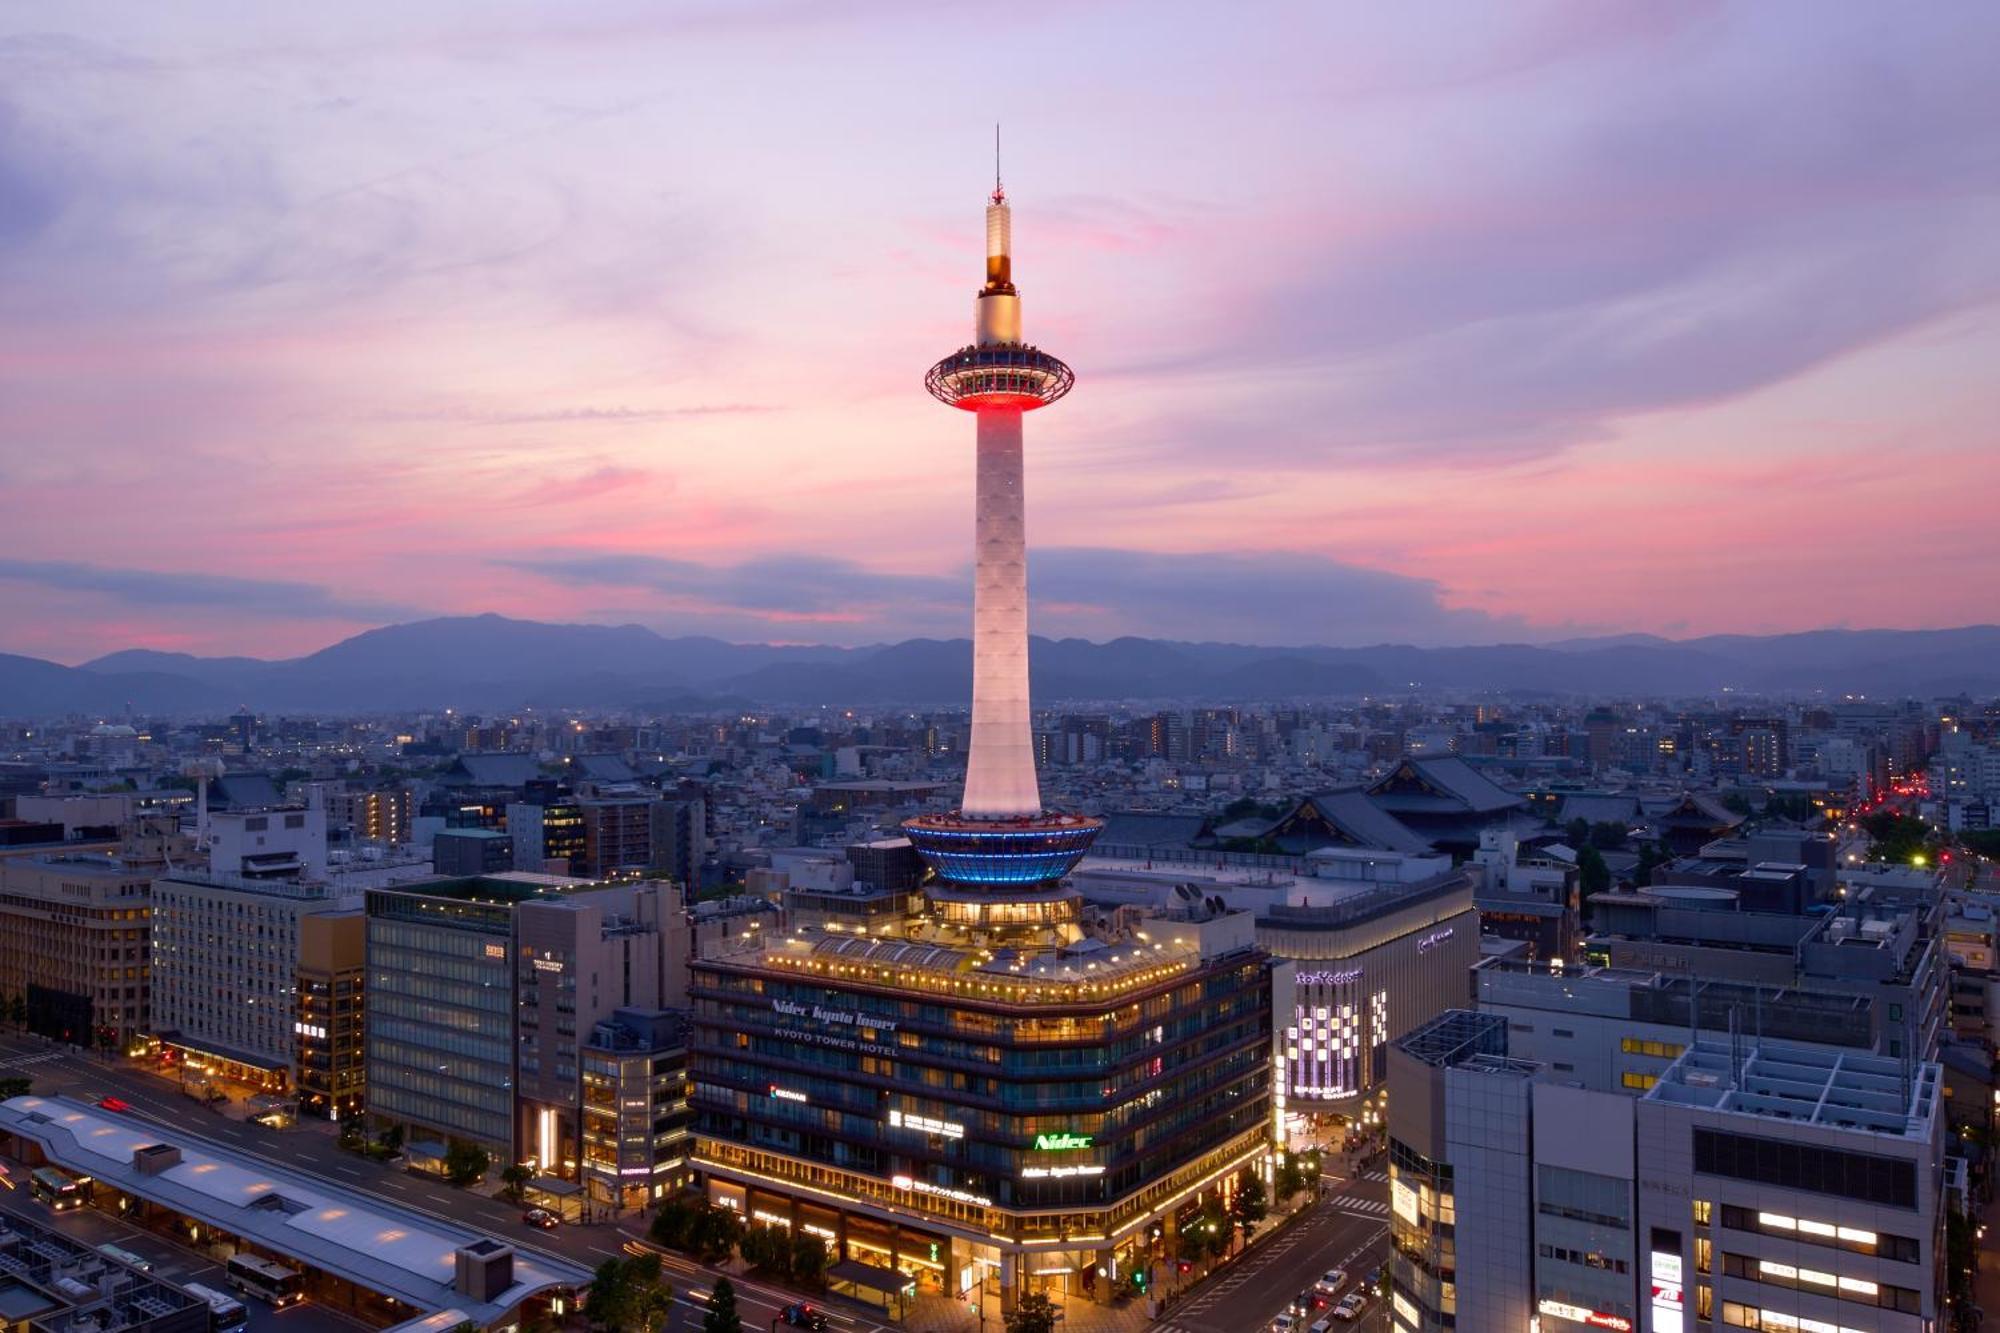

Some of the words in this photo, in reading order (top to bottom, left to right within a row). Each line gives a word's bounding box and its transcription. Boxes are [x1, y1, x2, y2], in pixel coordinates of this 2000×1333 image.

[772, 999, 806, 1016] Nidec
[812, 1005, 855, 1025] Kyoto
[856, 1012, 897, 1031] Tower
[775, 1028, 812, 1041] KYOTO
[816, 1035, 856, 1049] TOWER
[859, 1044, 899, 1057] HOTEL
[1034, 1133, 1093, 1150] Nidec
